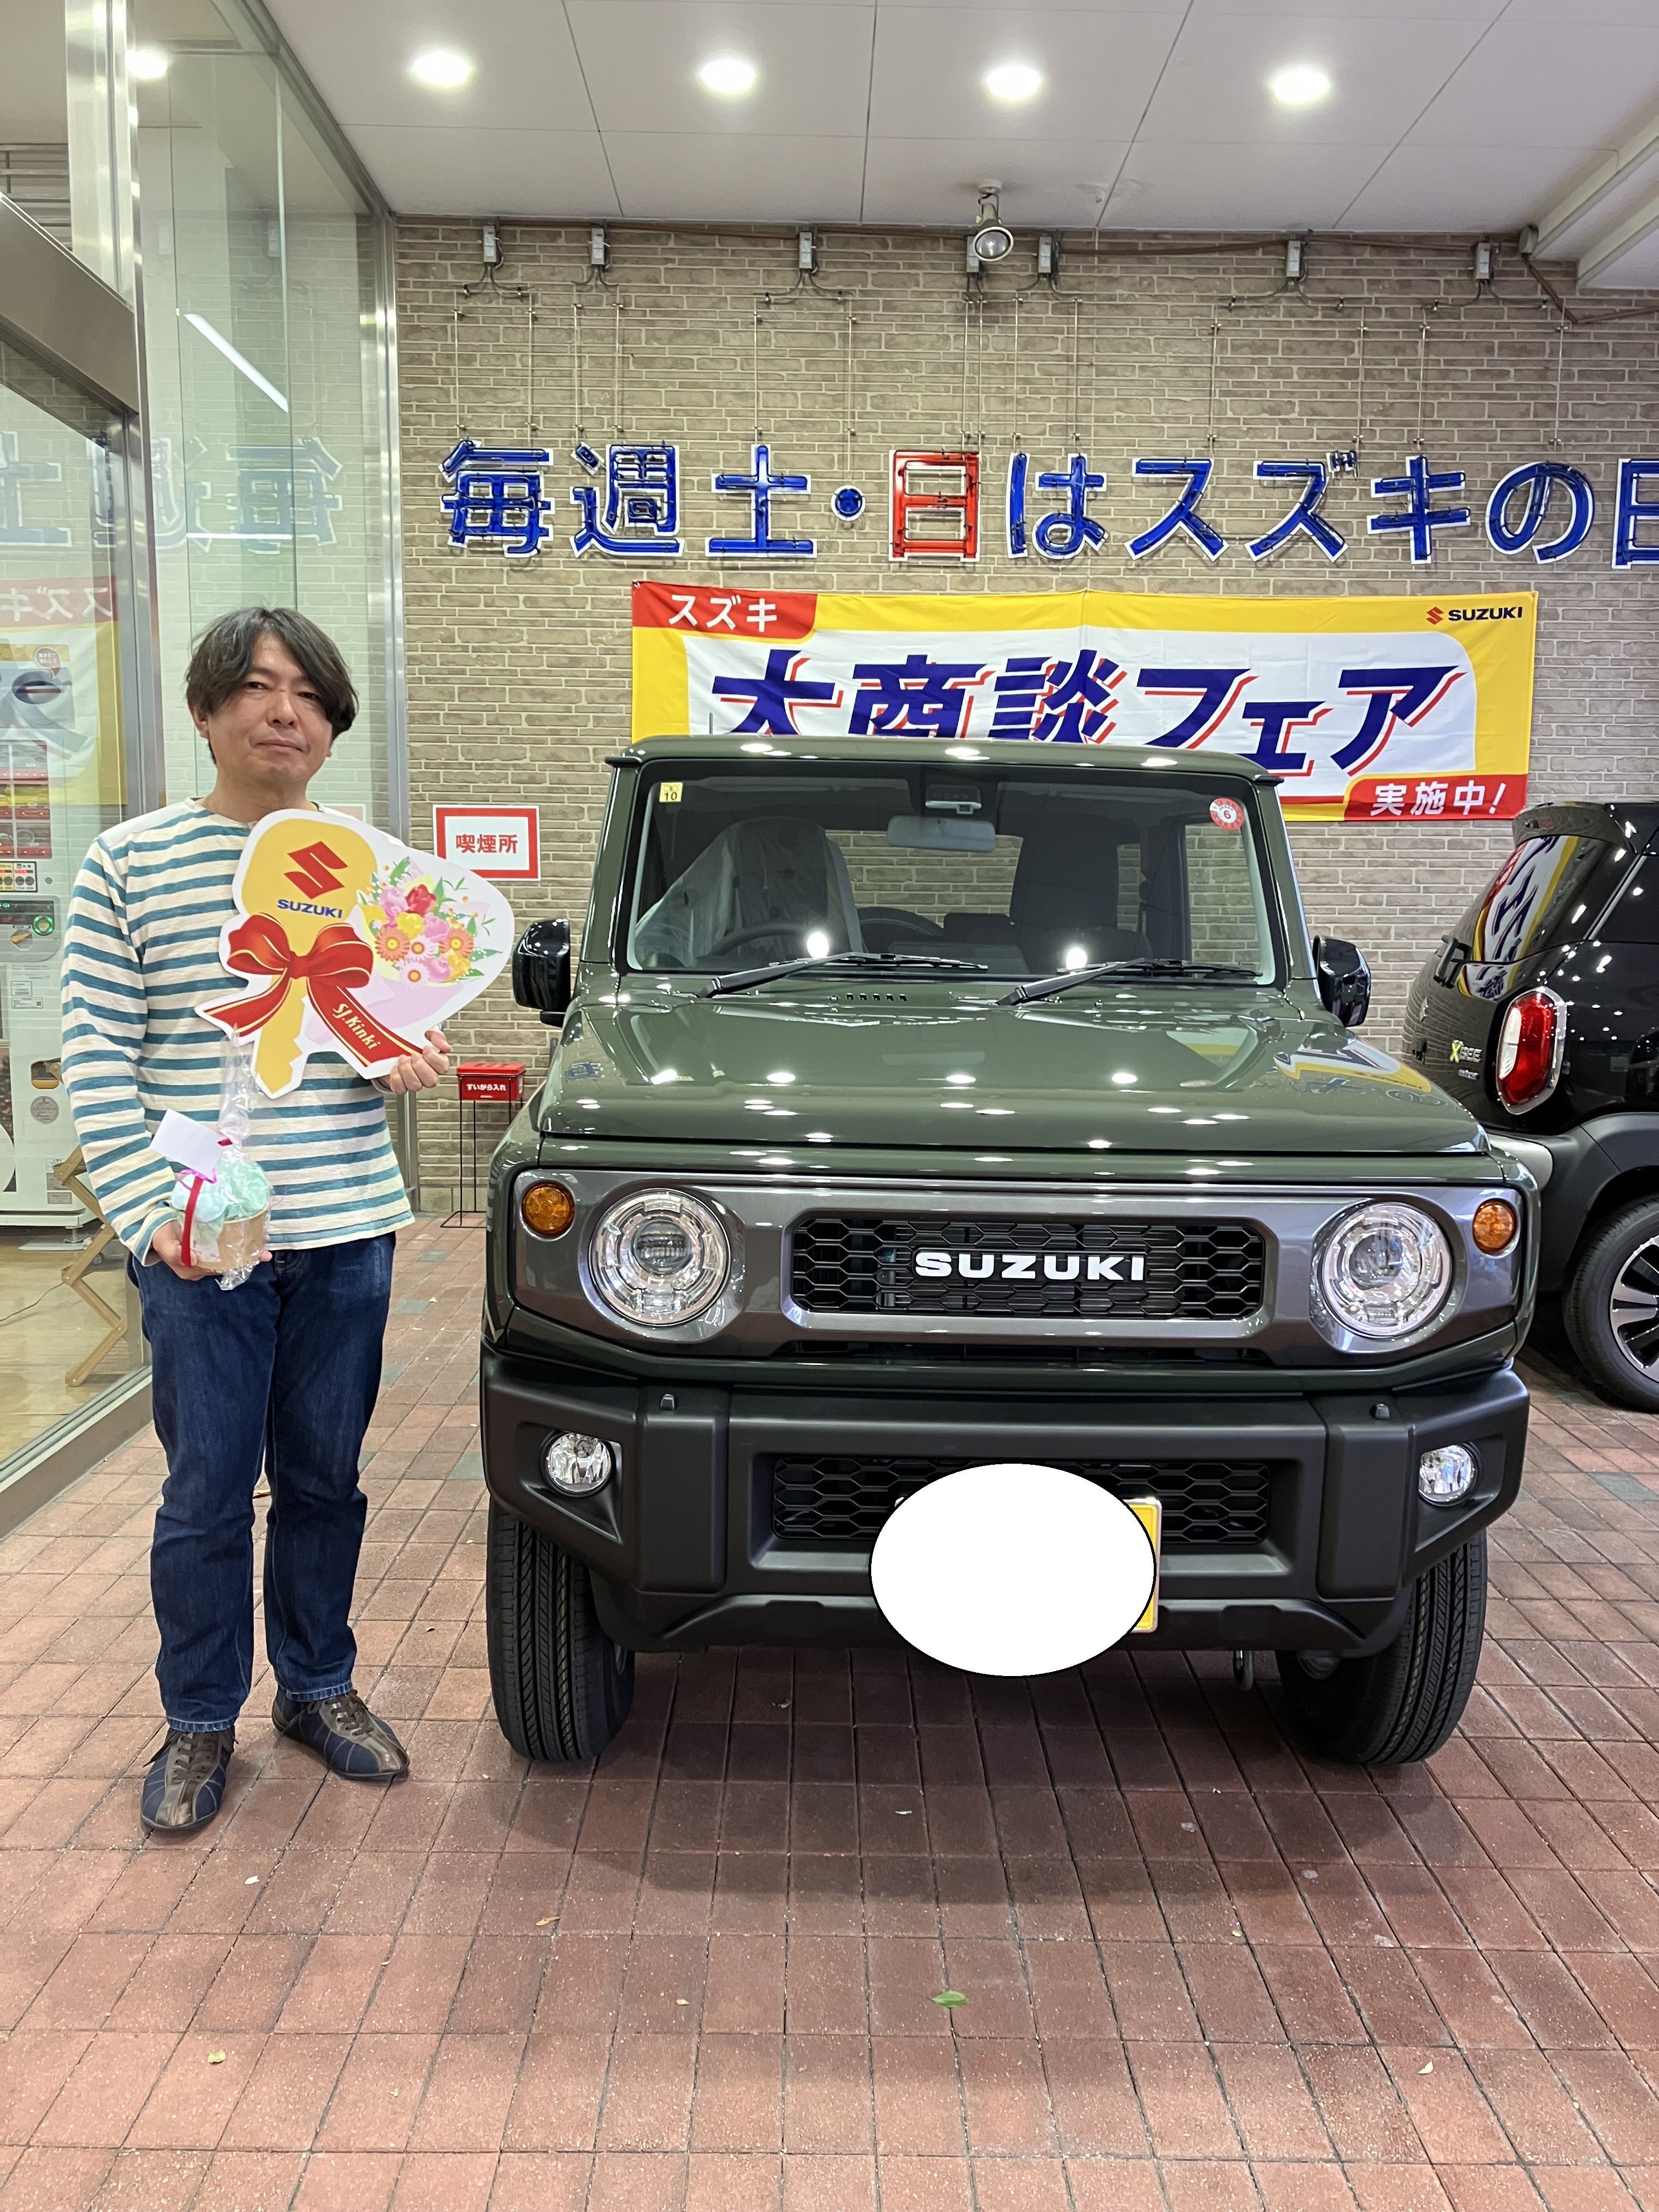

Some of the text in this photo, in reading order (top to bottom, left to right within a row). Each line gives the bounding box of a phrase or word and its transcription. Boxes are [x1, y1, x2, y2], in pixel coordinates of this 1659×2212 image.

[668, 594, 778, 633] スズキ
[1448, 606, 1523, 621] SUZUKI
[664, 792, 678, 801] 10
[1223, 810, 1231, 819] 6
[455, 833, 518, 854] 喫煙所
[276, 899, 343, 919] SUZUKI
[1449, 1040, 1482, 1063] XBEE
[915, 1252, 1144, 1282] SUZUKI
